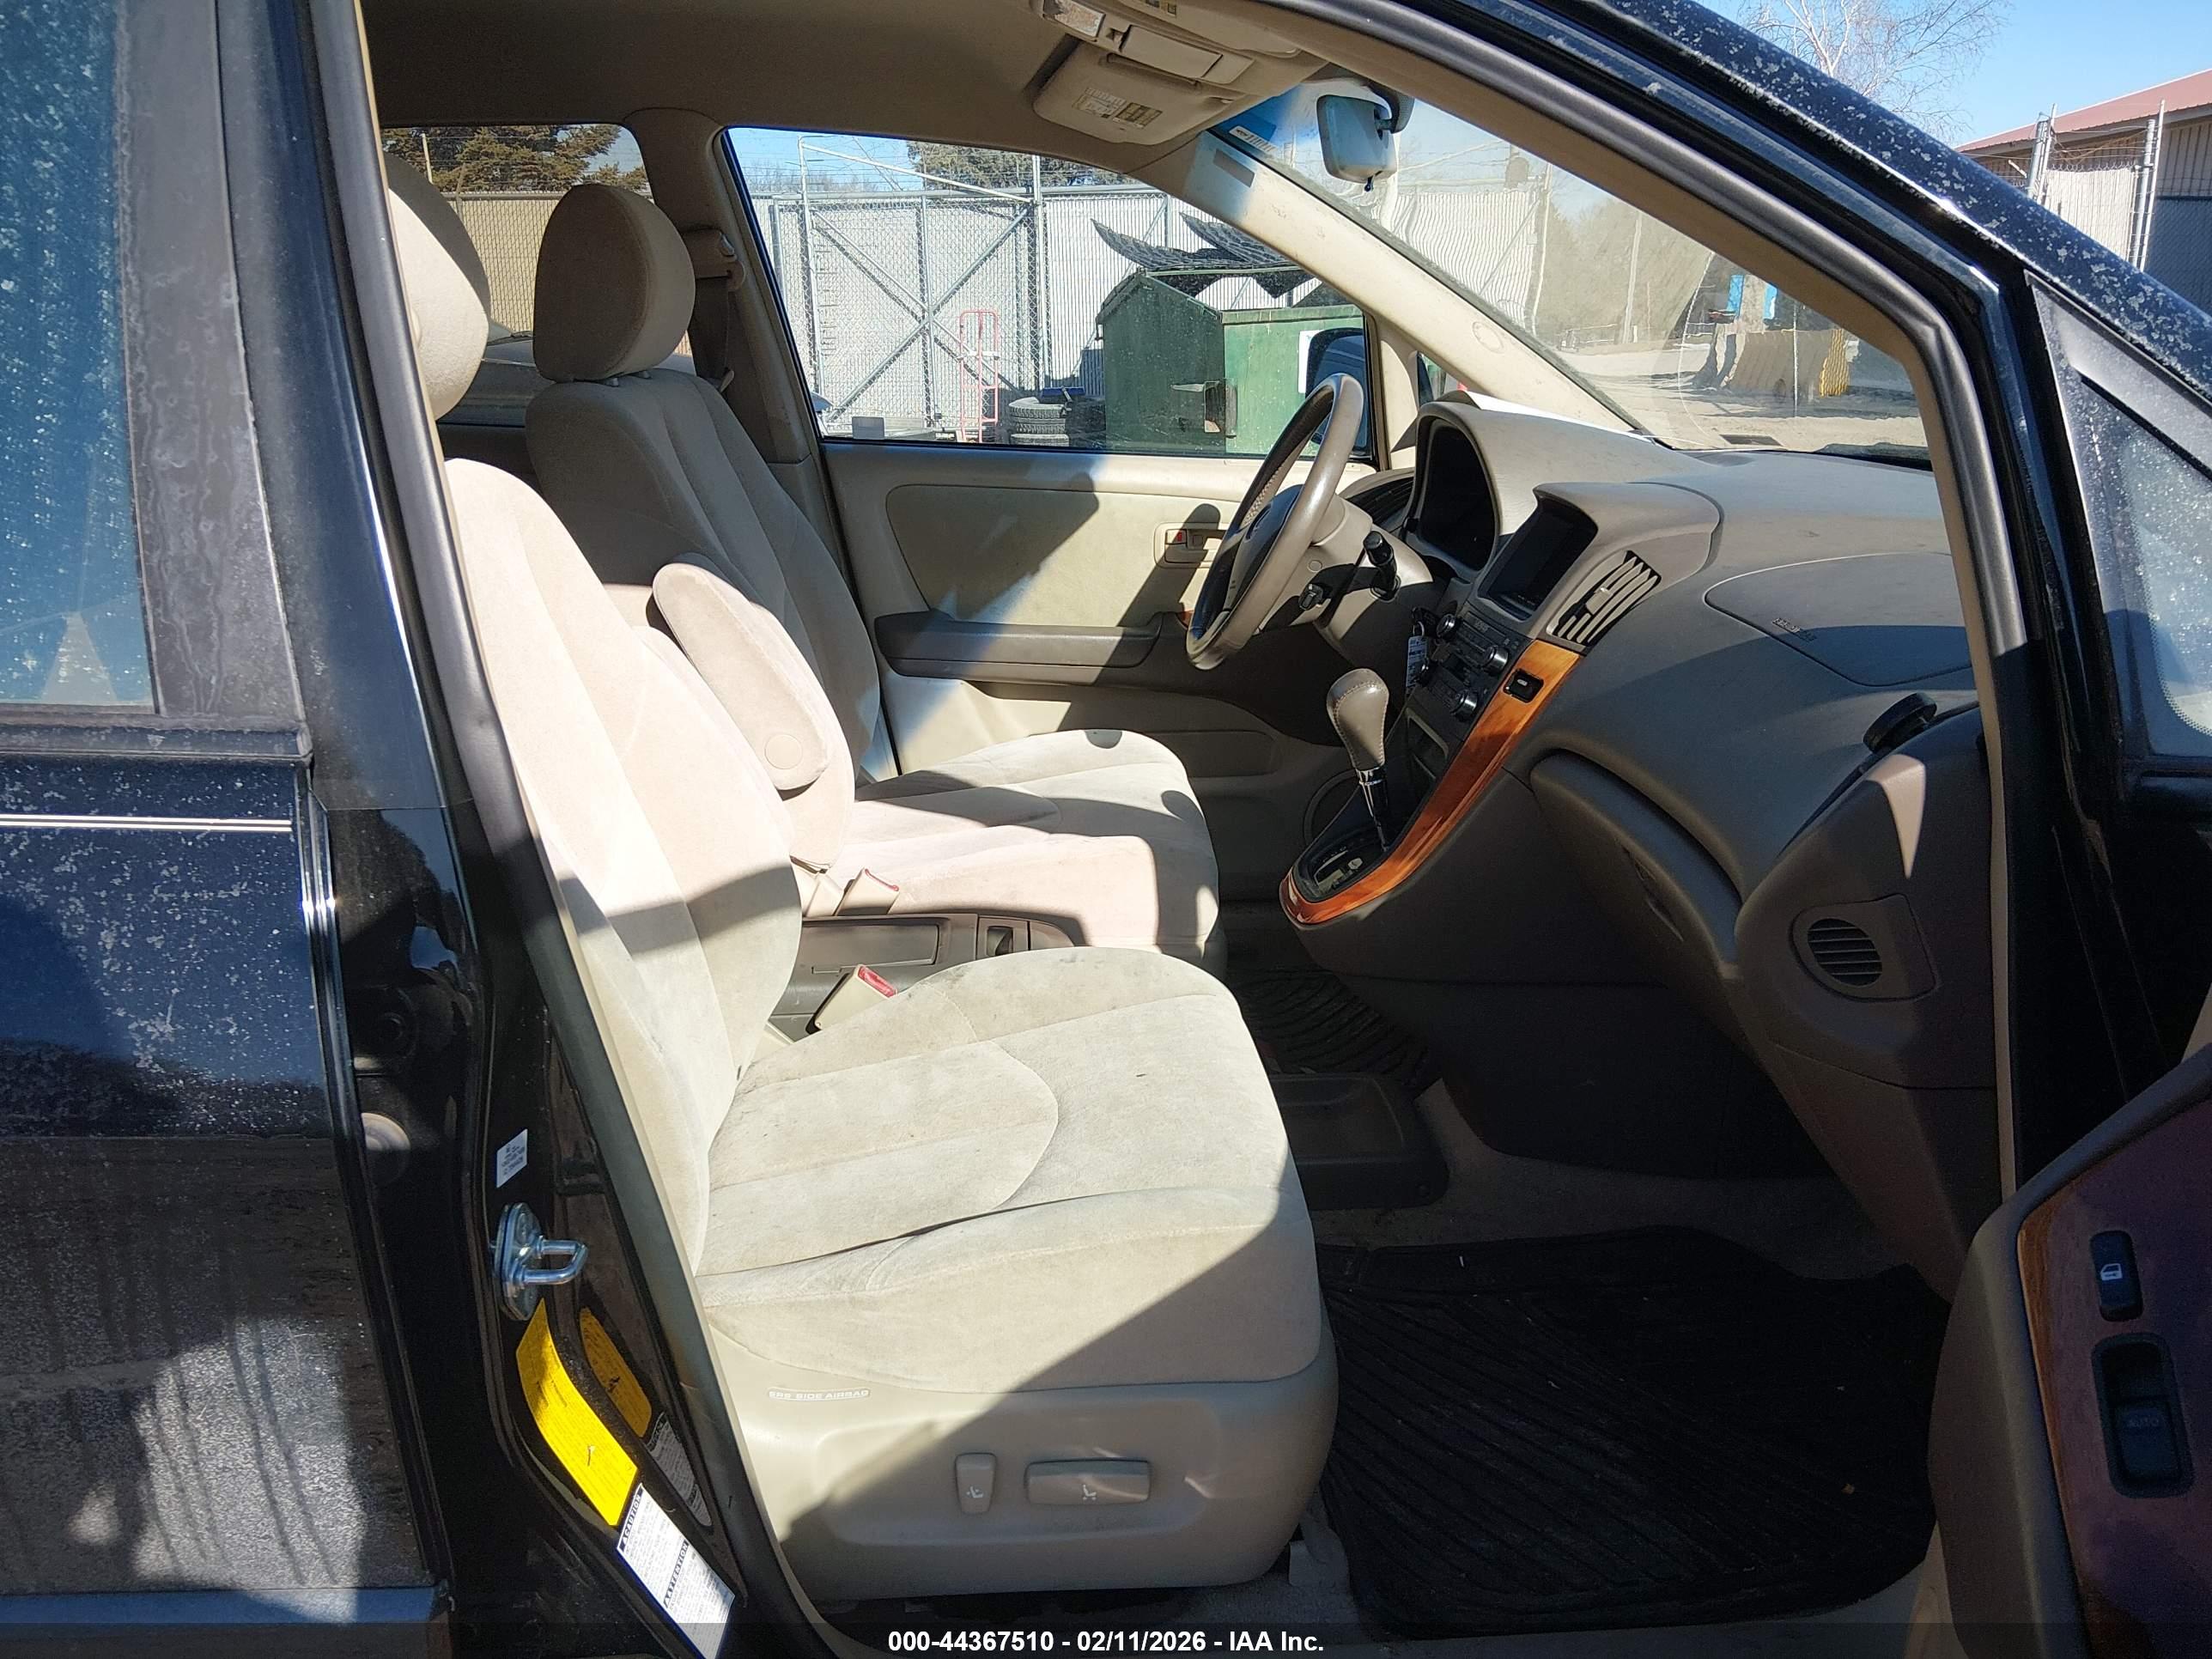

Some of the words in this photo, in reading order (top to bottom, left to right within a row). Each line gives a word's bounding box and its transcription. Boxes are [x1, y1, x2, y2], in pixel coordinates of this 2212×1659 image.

[824, 1389, 869, 1400] AIRBAG
[624, 1493, 642, 1537] CAUTION
[666, 1541, 688, 1598] ATTENTION
